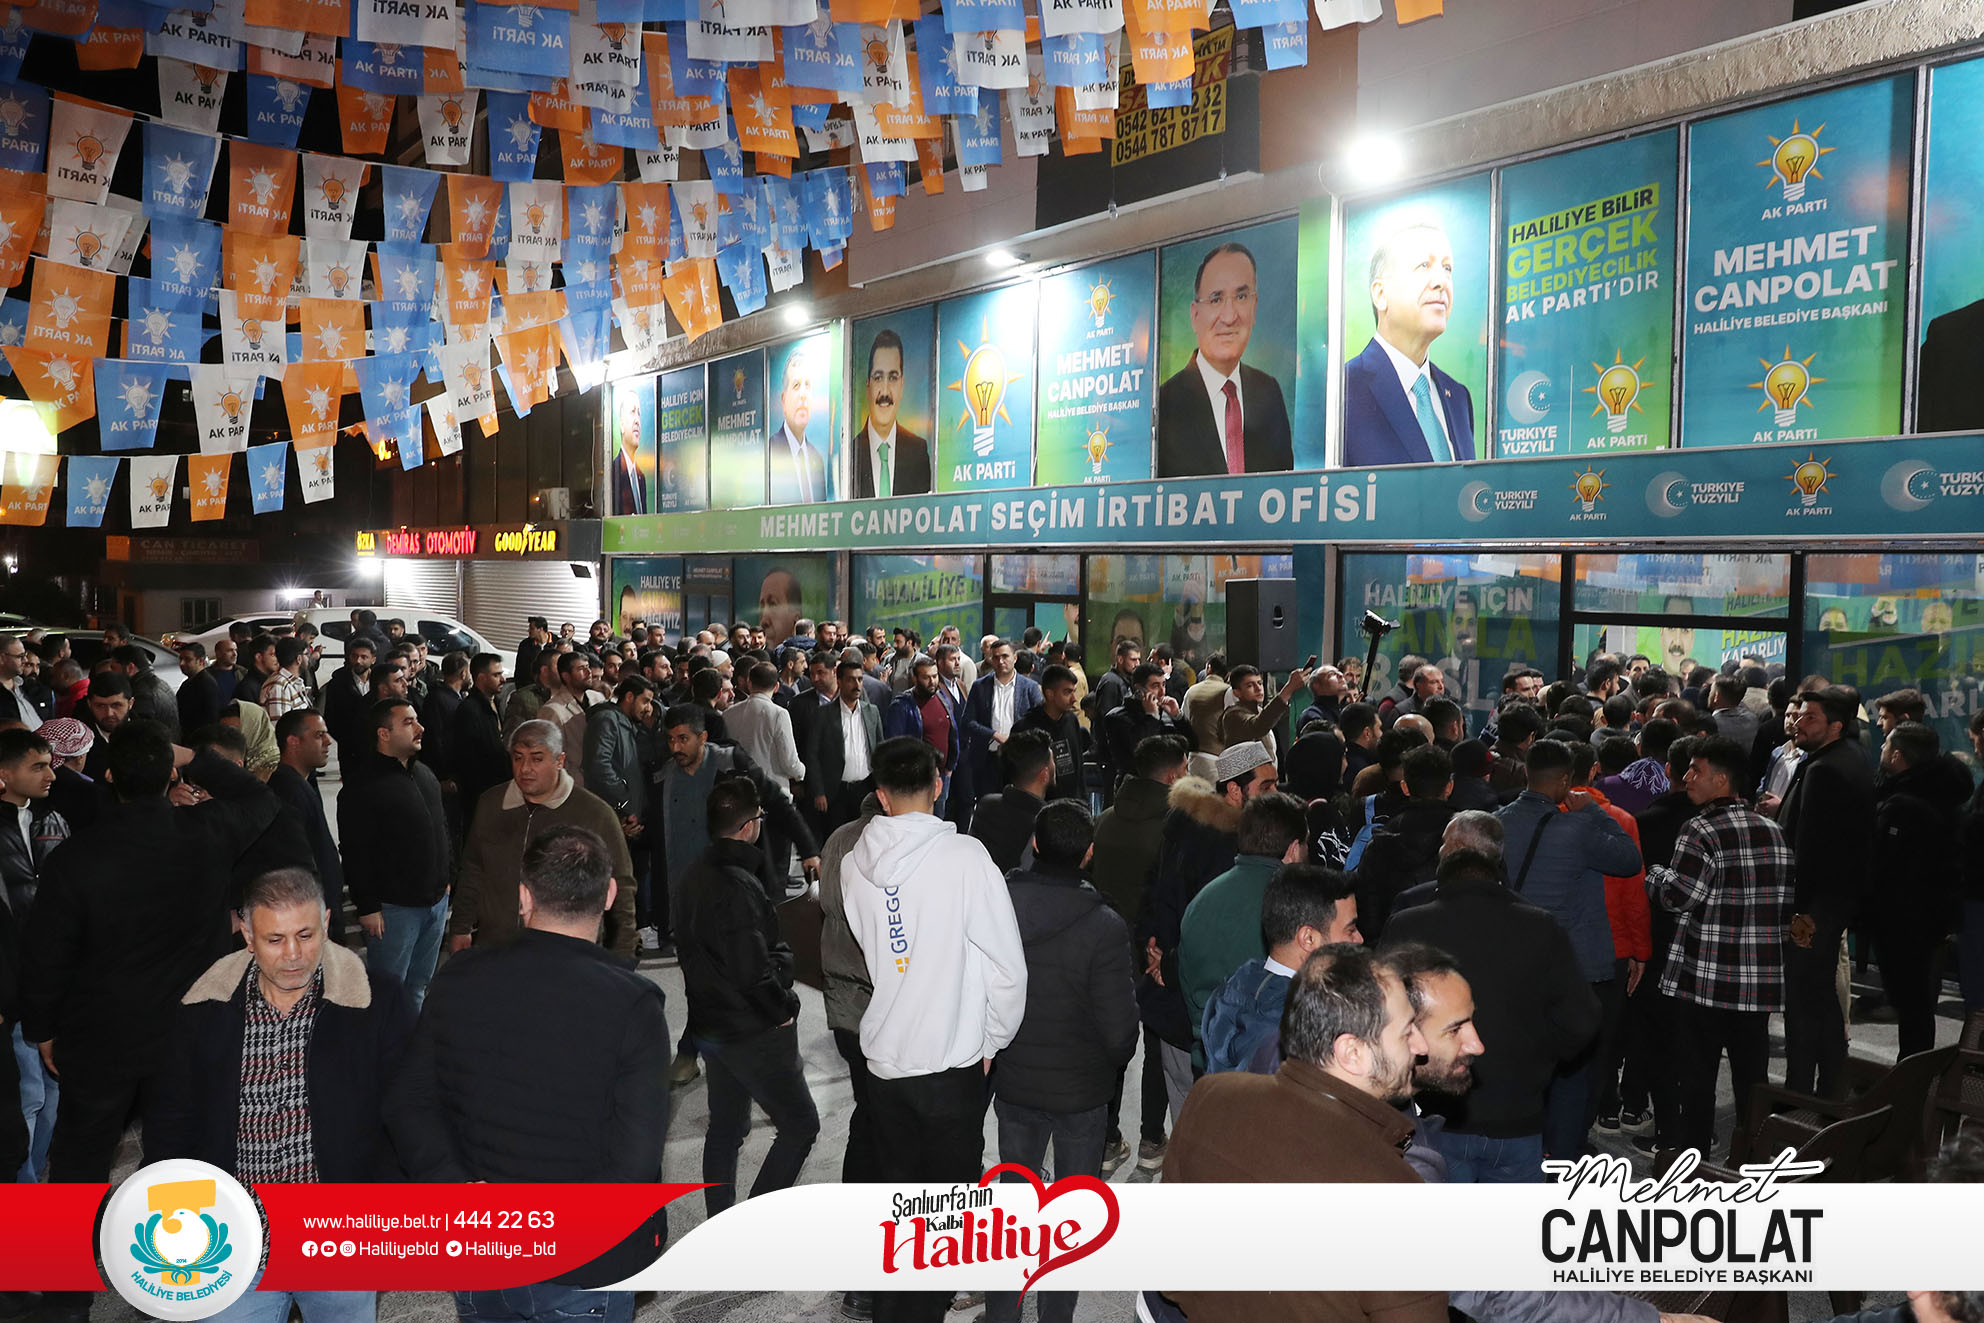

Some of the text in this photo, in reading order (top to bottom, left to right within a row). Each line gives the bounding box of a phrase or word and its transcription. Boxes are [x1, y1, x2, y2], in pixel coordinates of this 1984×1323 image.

[1117, 109, 1146, 138] 0542
[1117, 109, 1221, 162] 0544 787 87 17
[1512, 188, 1653, 244] HALİLİYE BİLİR
[1761, 207, 1782, 221] AK
[1507, 210, 1659, 279] GERÇEK
[1713, 225, 1877, 277] MEHMET
[1506, 248, 1657, 303] BELEDİYECİLİK
[1694, 259, 1898, 312] CANPOLAT
[1506, 300, 1536, 322] AK
[1694, 301, 1888, 335] HALİLİYE BELEDİYE BAŞKANI
[1057, 342, 1134, 376] MEHMET
[1048, 369, 1144, 403] CANPOLAT
[718, 410, 756, 431] MEHMET
[1587, 437, 1605, 449] AK
[1752, 431, 1773, 443] AK
[953, 464, 972, 482] AK
[760, 472, 1377, 538] MEHMET CANPOLAT SEÇİM İRTİBAT OFİSİ
[1570, 513, 1582, 521] AK
[1786, 508, 1800, 517] AK
[426, 524, 477, 555] OTOMOTİV
[495, 524, 556, 556] GOODYEAR
